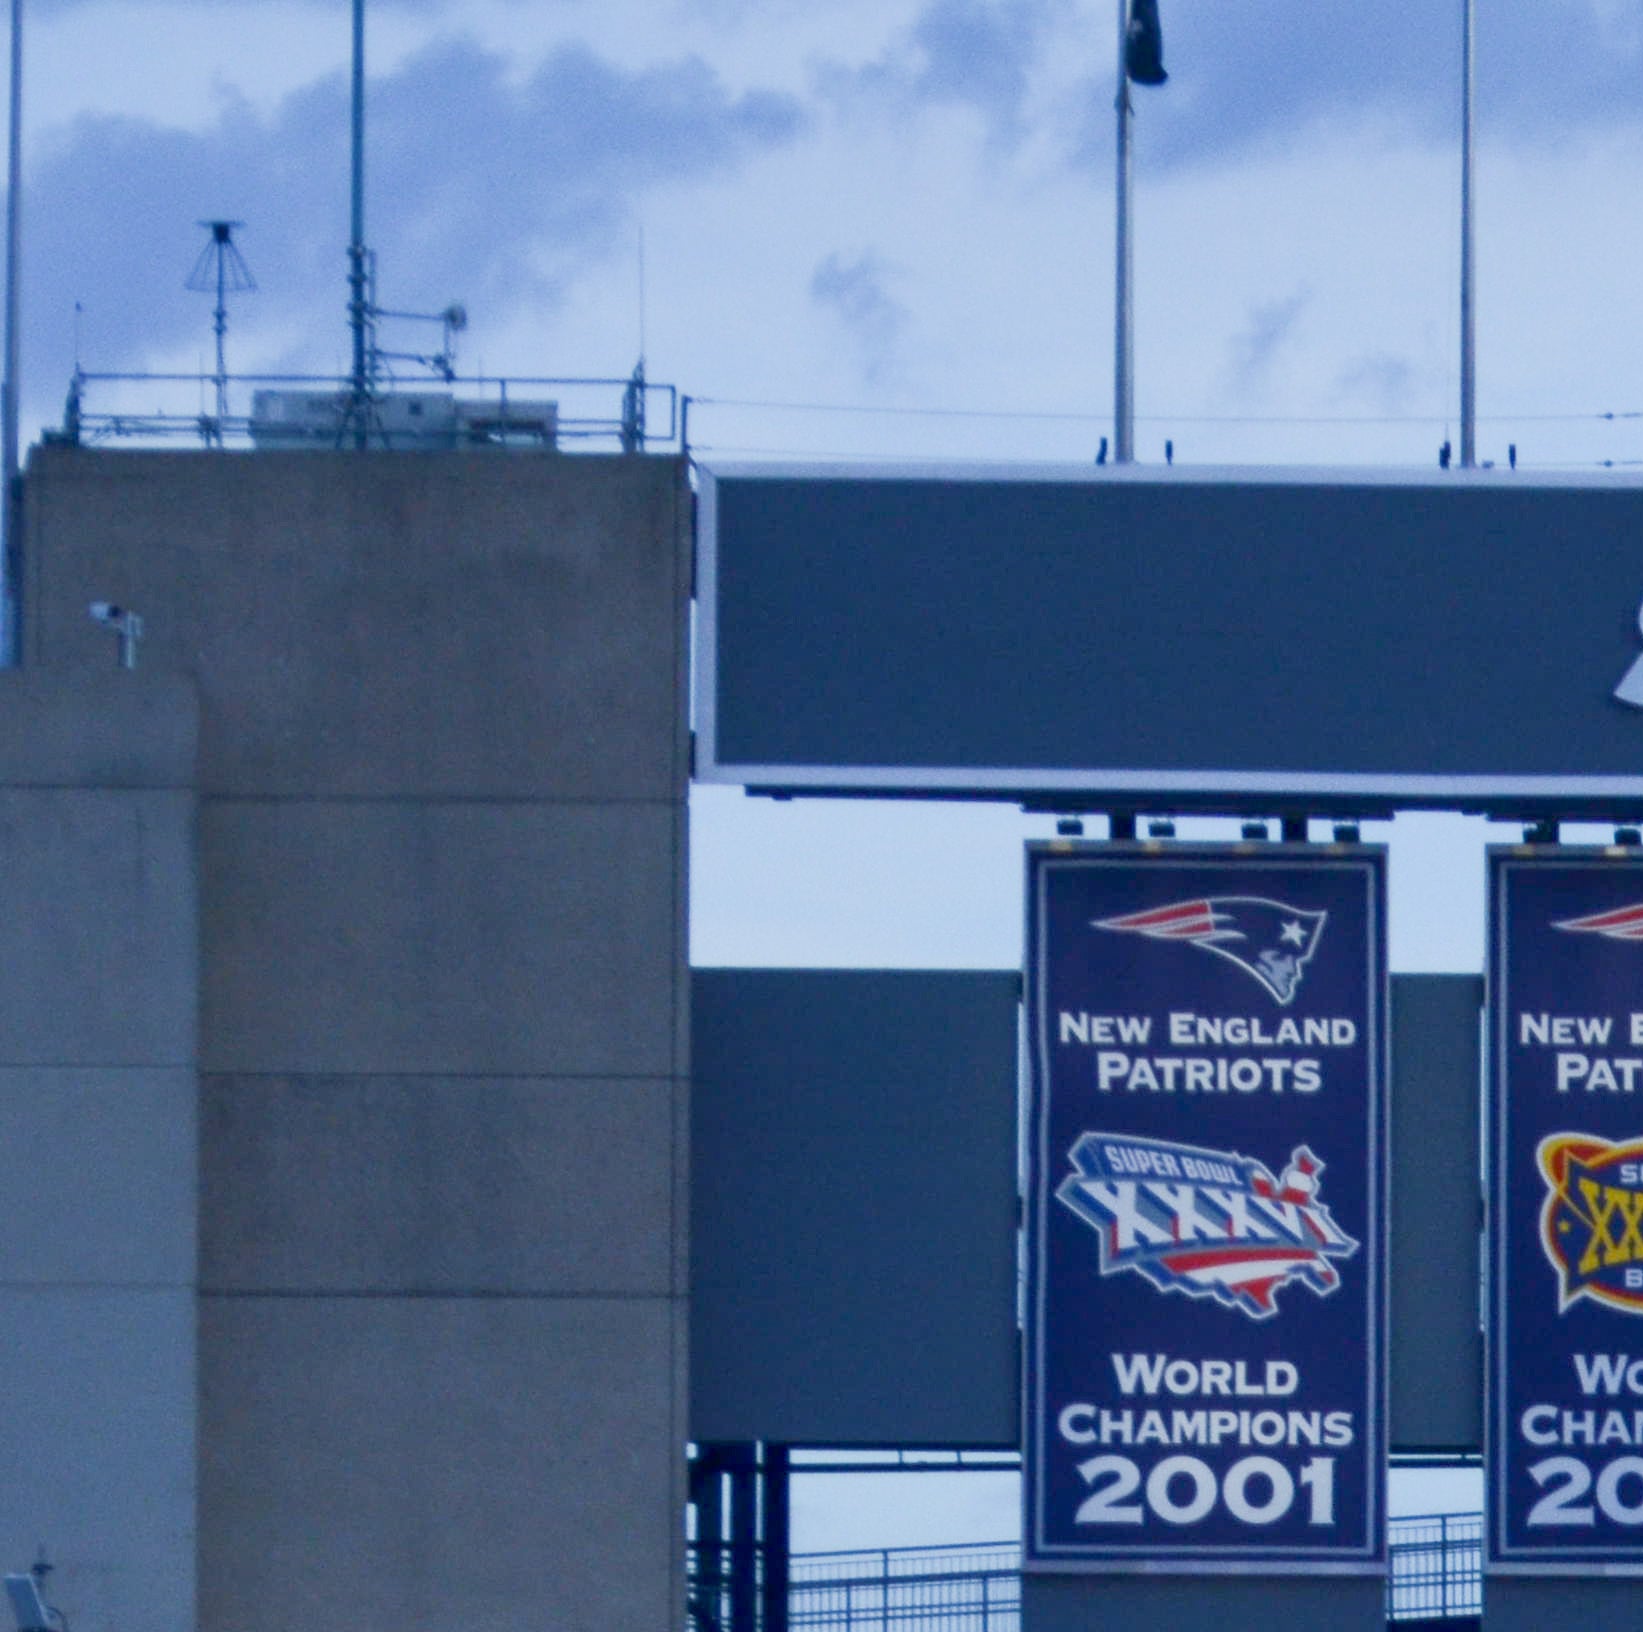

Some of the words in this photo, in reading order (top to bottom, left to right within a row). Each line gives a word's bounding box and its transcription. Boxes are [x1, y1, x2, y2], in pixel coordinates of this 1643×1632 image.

[1060, 1012, 1151, 1043] NEW
[1170, 1013, 1355, 1045] ENGLAND
[1521, 1013, 1612, 1044] NEW
[1098, 1052, 1321, 1092] PATRIOTS
[1104, 1147, 1182, 1178] SUPER
[1180, 1158, 1244, 1186] BOWL
[1112, 1354, 1298, 1395] WORLD
[1059, 1404, 1352, 1446] CHAMPIONS
[1076, 1455, 1334, 1524] 2001
